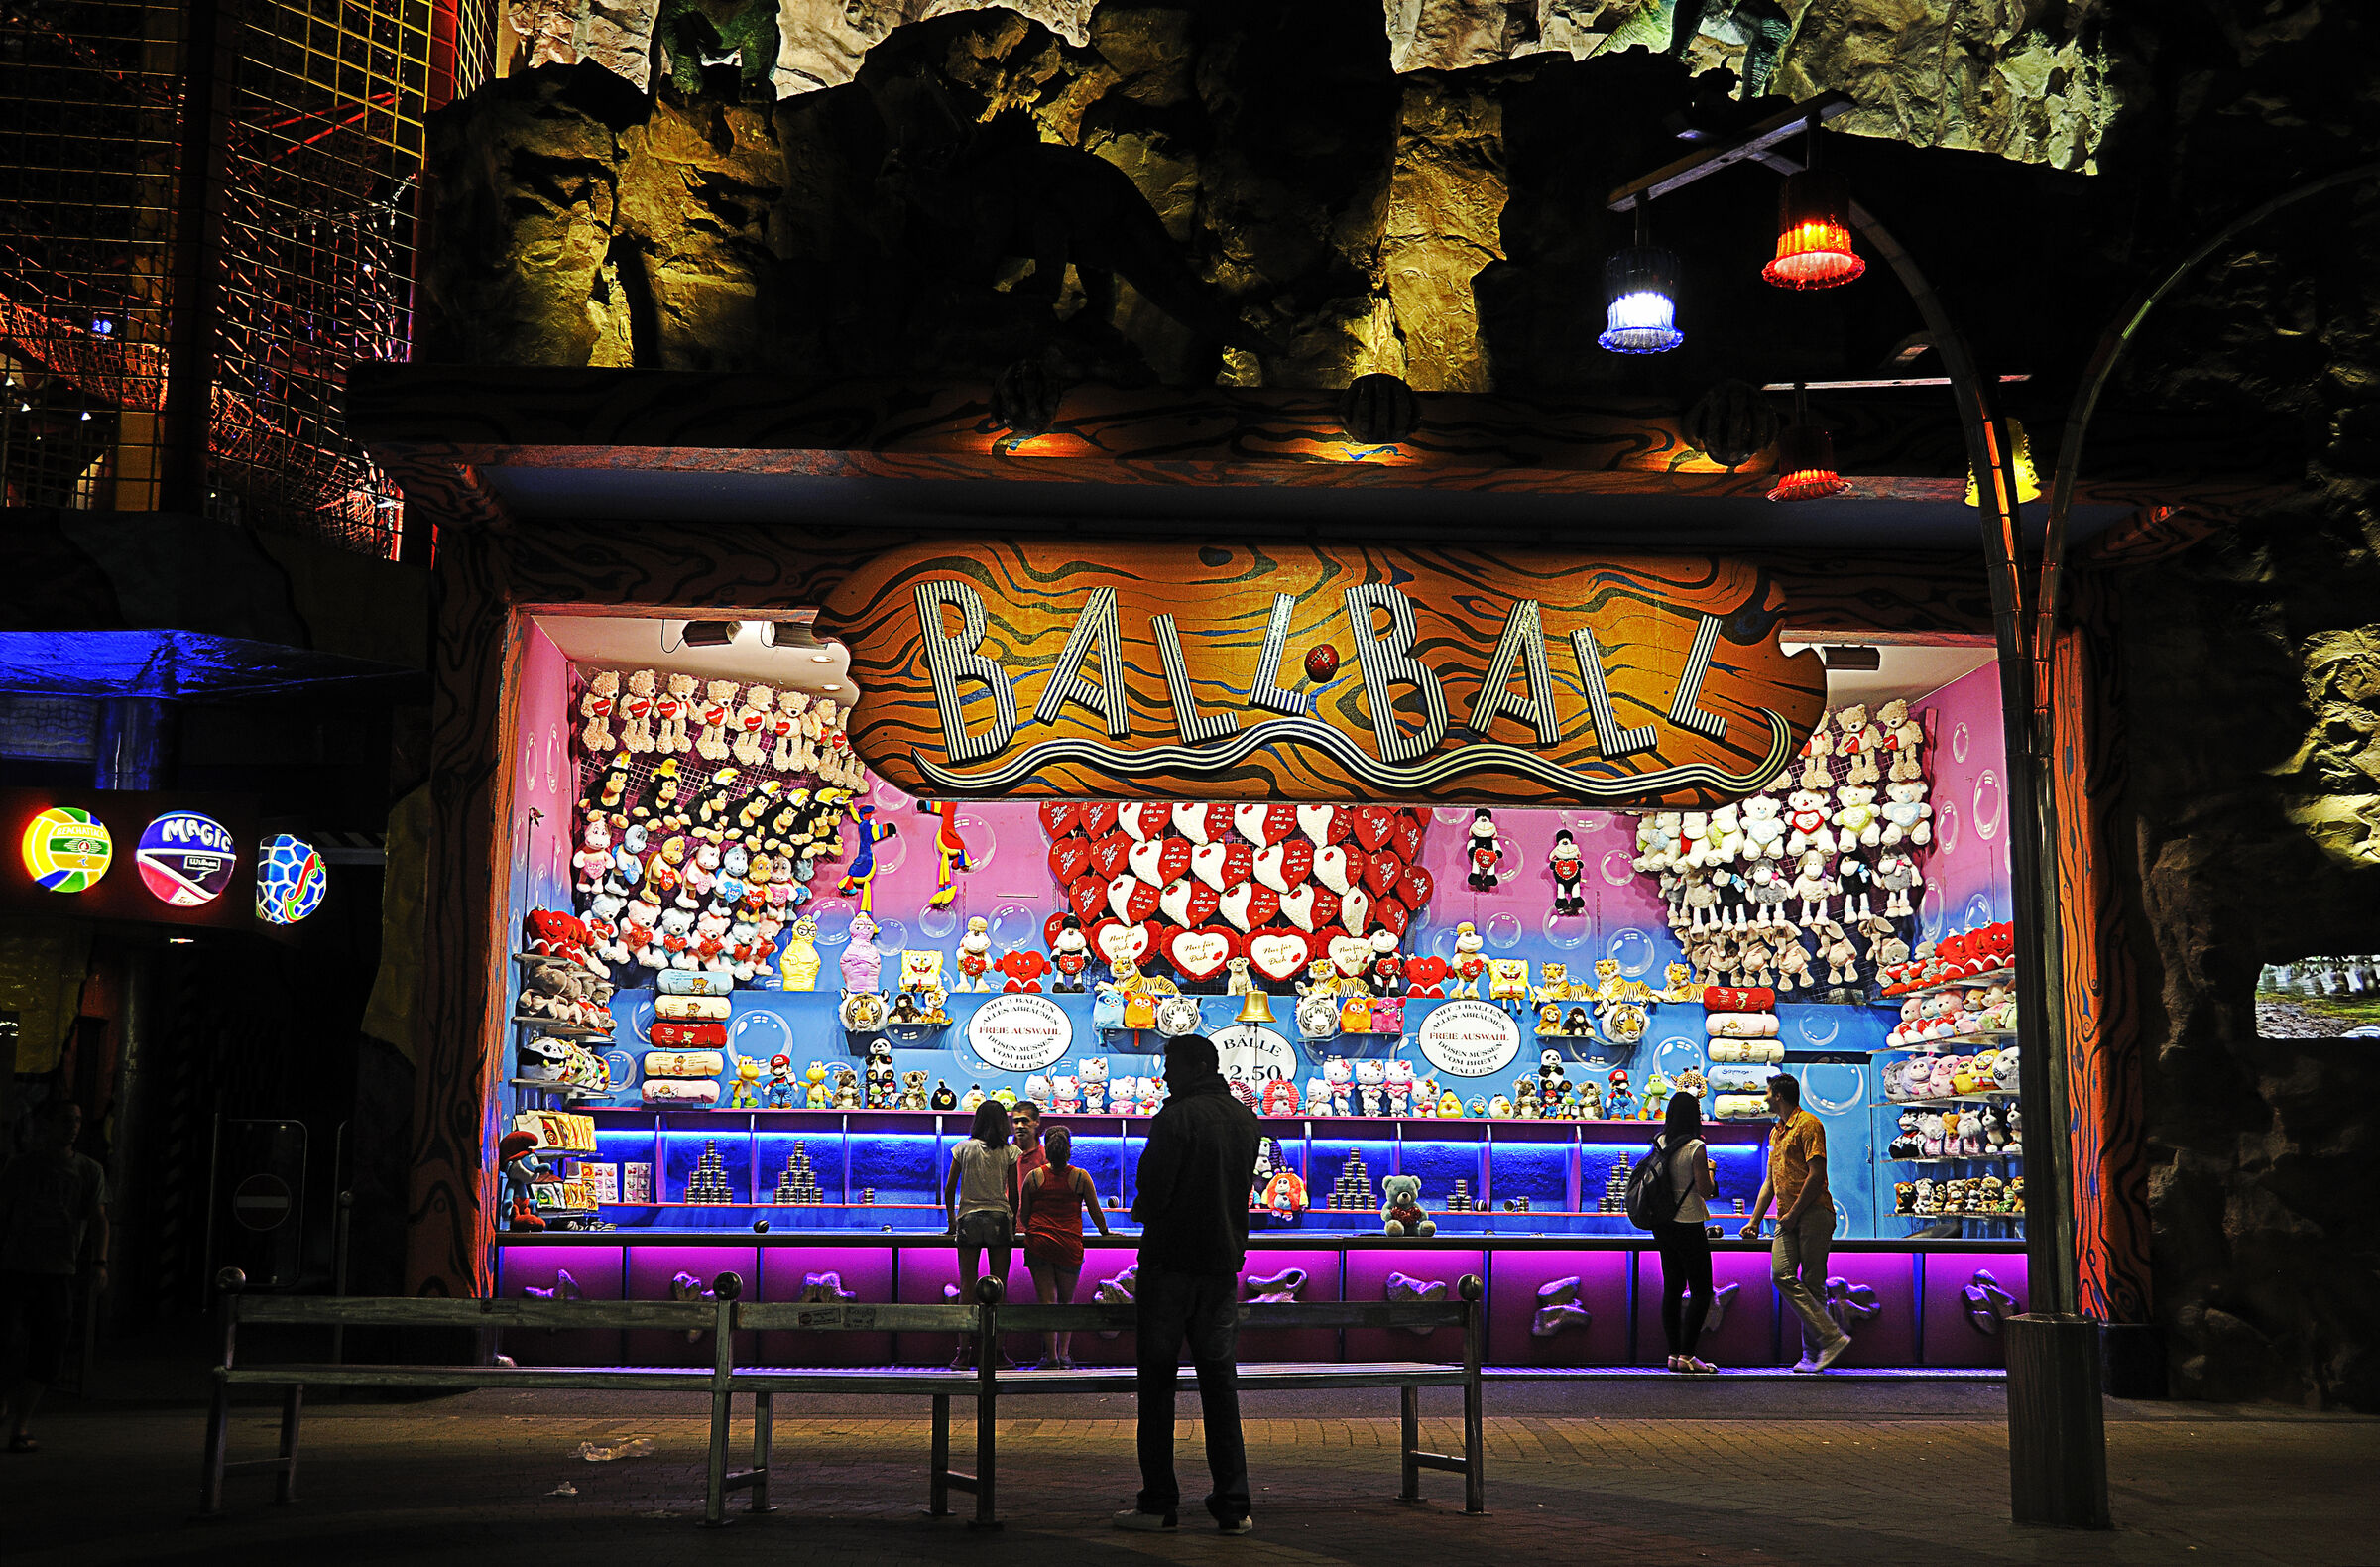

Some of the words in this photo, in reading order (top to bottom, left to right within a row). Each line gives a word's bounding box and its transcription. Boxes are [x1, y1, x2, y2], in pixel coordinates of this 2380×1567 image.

[914, 582, 1310, 763] BALL
[1344, 583, 1728, 764] BALL
[984, 1008, 1010, 1025] ALLES
[1433, 1014, 1458, 1031] ALLES
[988, 1035, 1017, 1051] DOSEN
[1223, 1034, 1282, 1057] BÄLLE
[1438, 1041, 1468, 1057] DOSEN
[993, 1047, 1013, 1059] VOM
[1016, 1047, 1049, 1061] BRETT
[1443, 1053, 1464, 1065] VOM
[1466, 1053, 1498, 1066] BRETT
[1000, 1059, 1045, 1069] FALLEN
[1451, 1065, 1493, 1074] FALLEN
[1229, 1064, 1281, 1082] 2,50
